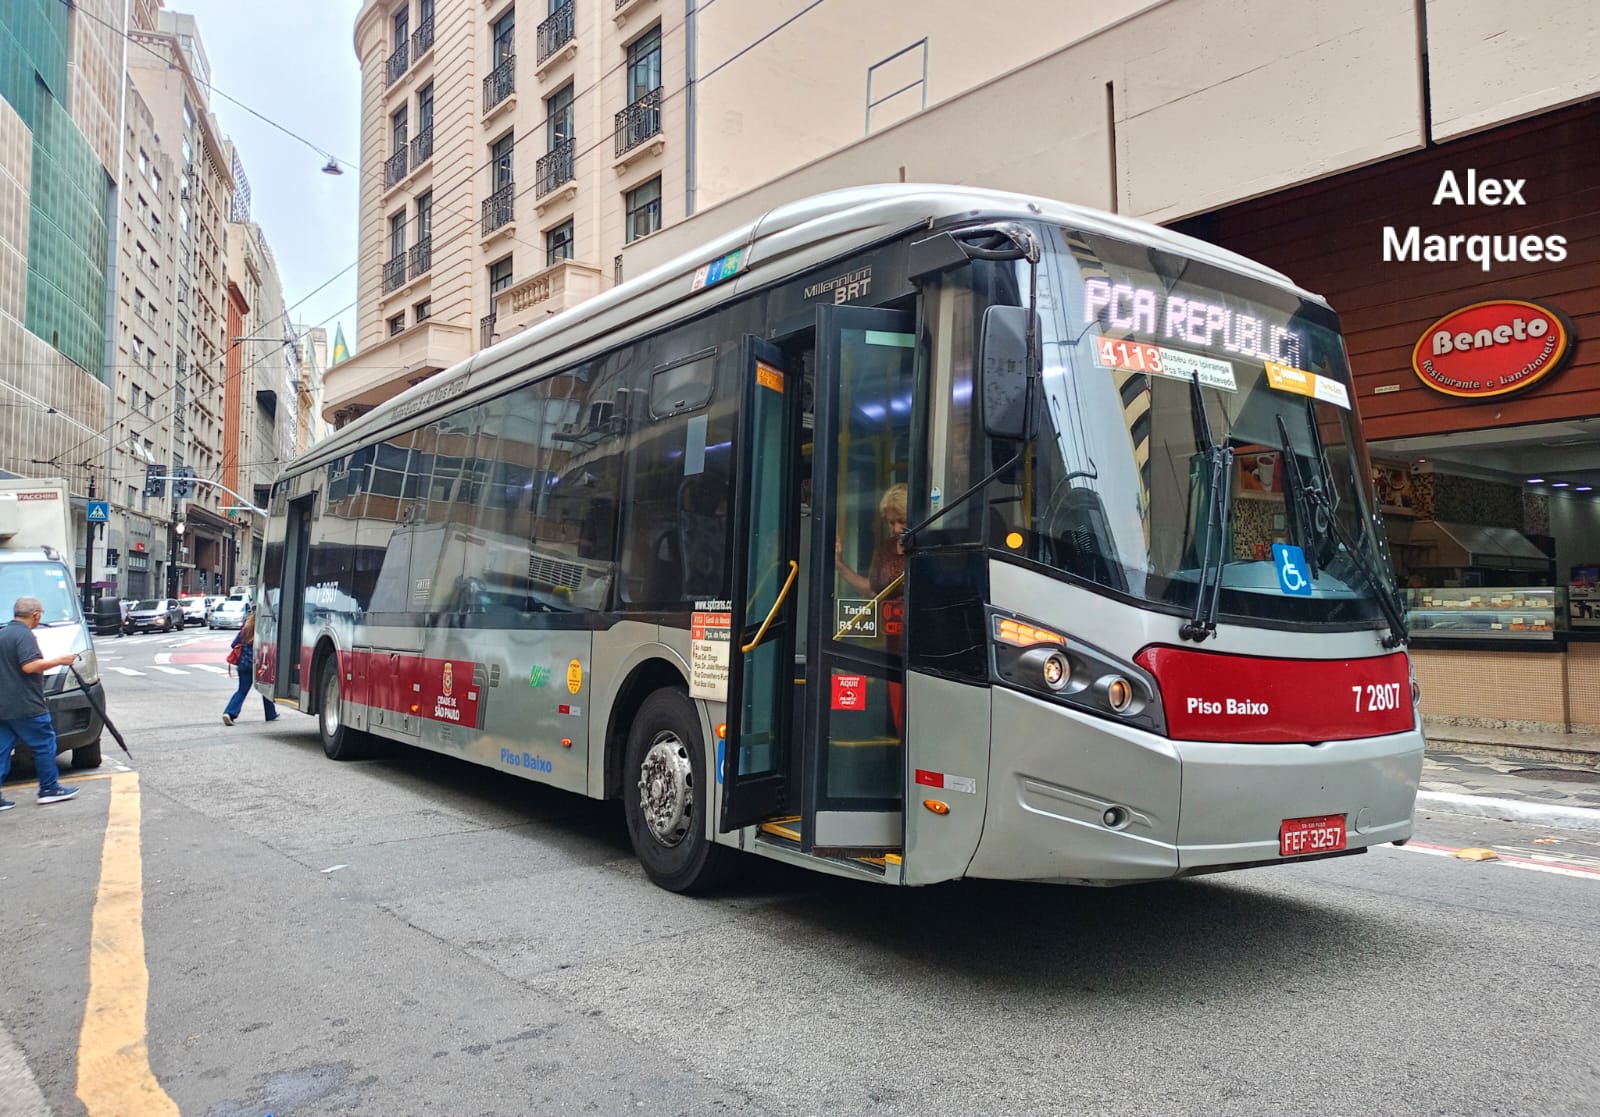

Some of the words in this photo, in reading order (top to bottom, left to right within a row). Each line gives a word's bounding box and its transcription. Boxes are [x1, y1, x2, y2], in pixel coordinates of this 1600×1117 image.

[804, 267, 872, 299] Millennium
[834, 277, 872, 305] BRT
[1084, 279, 1156, 335] PCA
[1432, 318, 1548, 356] Beneto
[1100, 341, 1164, 373] 4113
[1161, 351, 1187, 364] Museu
[1199, 359, 1230, 374] Ipiranga
[1422, 359, 1481, 389] Restaurante
[1486, 379, 1495, 388] e
[843, 605, 872, 616] Tarifa
[840, 620, 853, 632] R$
[854, 621, 875, 632] 4,40
[437, 695, 451, 707] CIDADE
[1187, 697, 1222, 715] Piso
[1226, 698, 1269, 716] Baixo
[1351, 685, 1362, 713] 7
[1366, 683, 1400, 712] 2807
[445, 706, 460, 721] PAULO
[500, 748, 521, 766] Piso
[523, 752, 553, 774] Baixo
